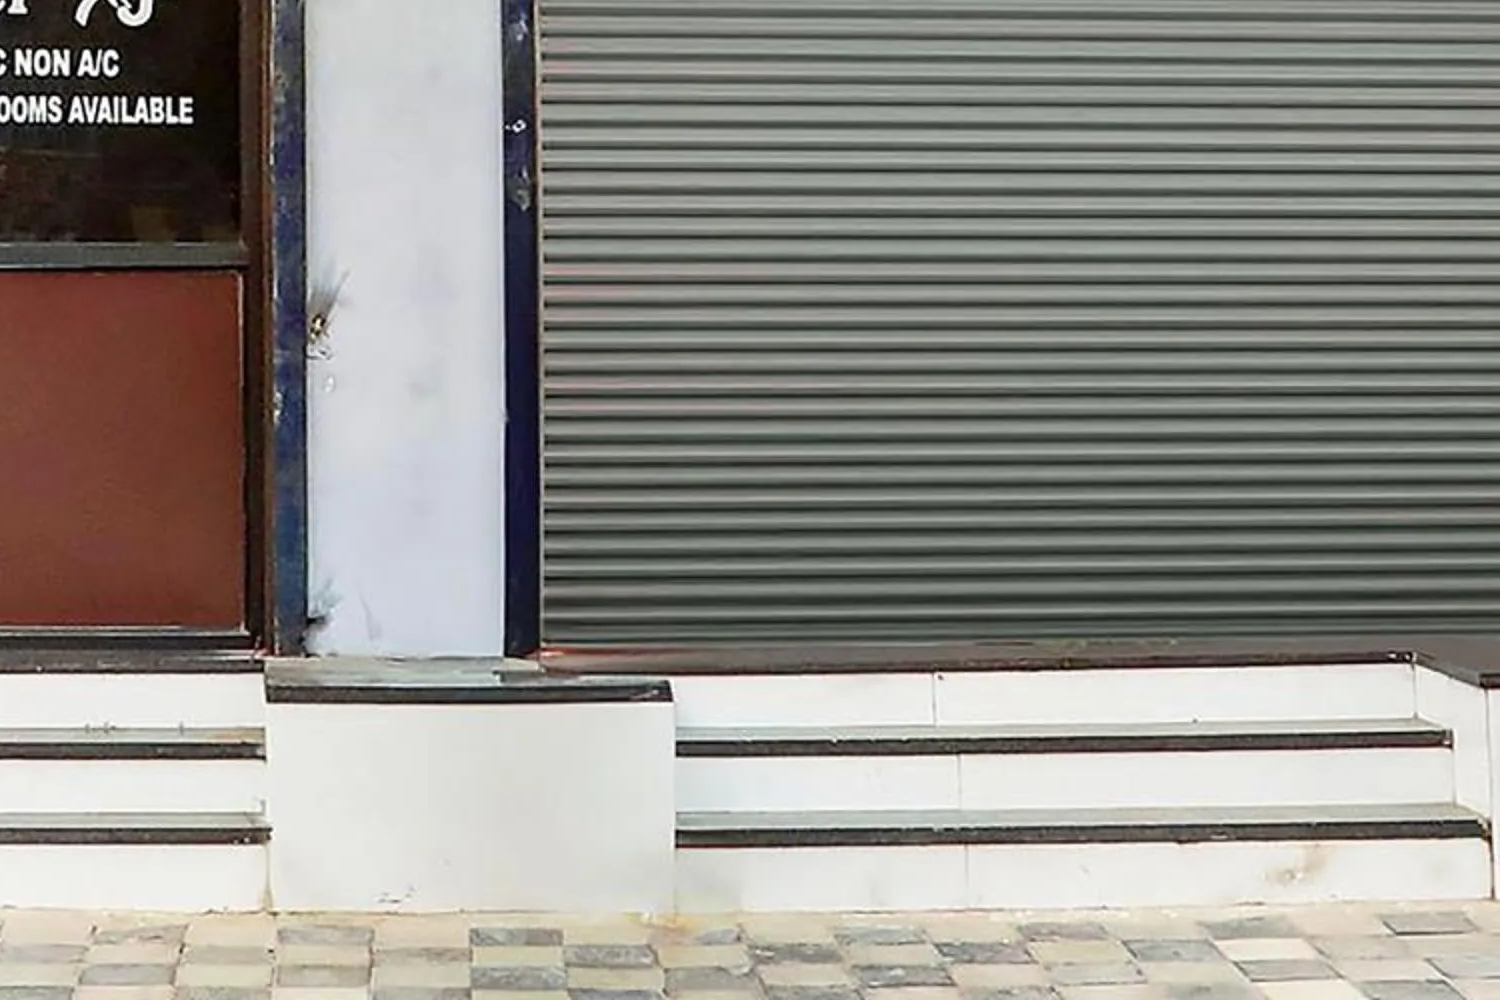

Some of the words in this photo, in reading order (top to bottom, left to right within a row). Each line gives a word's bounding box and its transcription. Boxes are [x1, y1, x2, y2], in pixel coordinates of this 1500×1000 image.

[13, 47, 71, 78] NON
[77, 48, 120, 78] A/C
[67, 95, 195, 125] AVAILABLE
